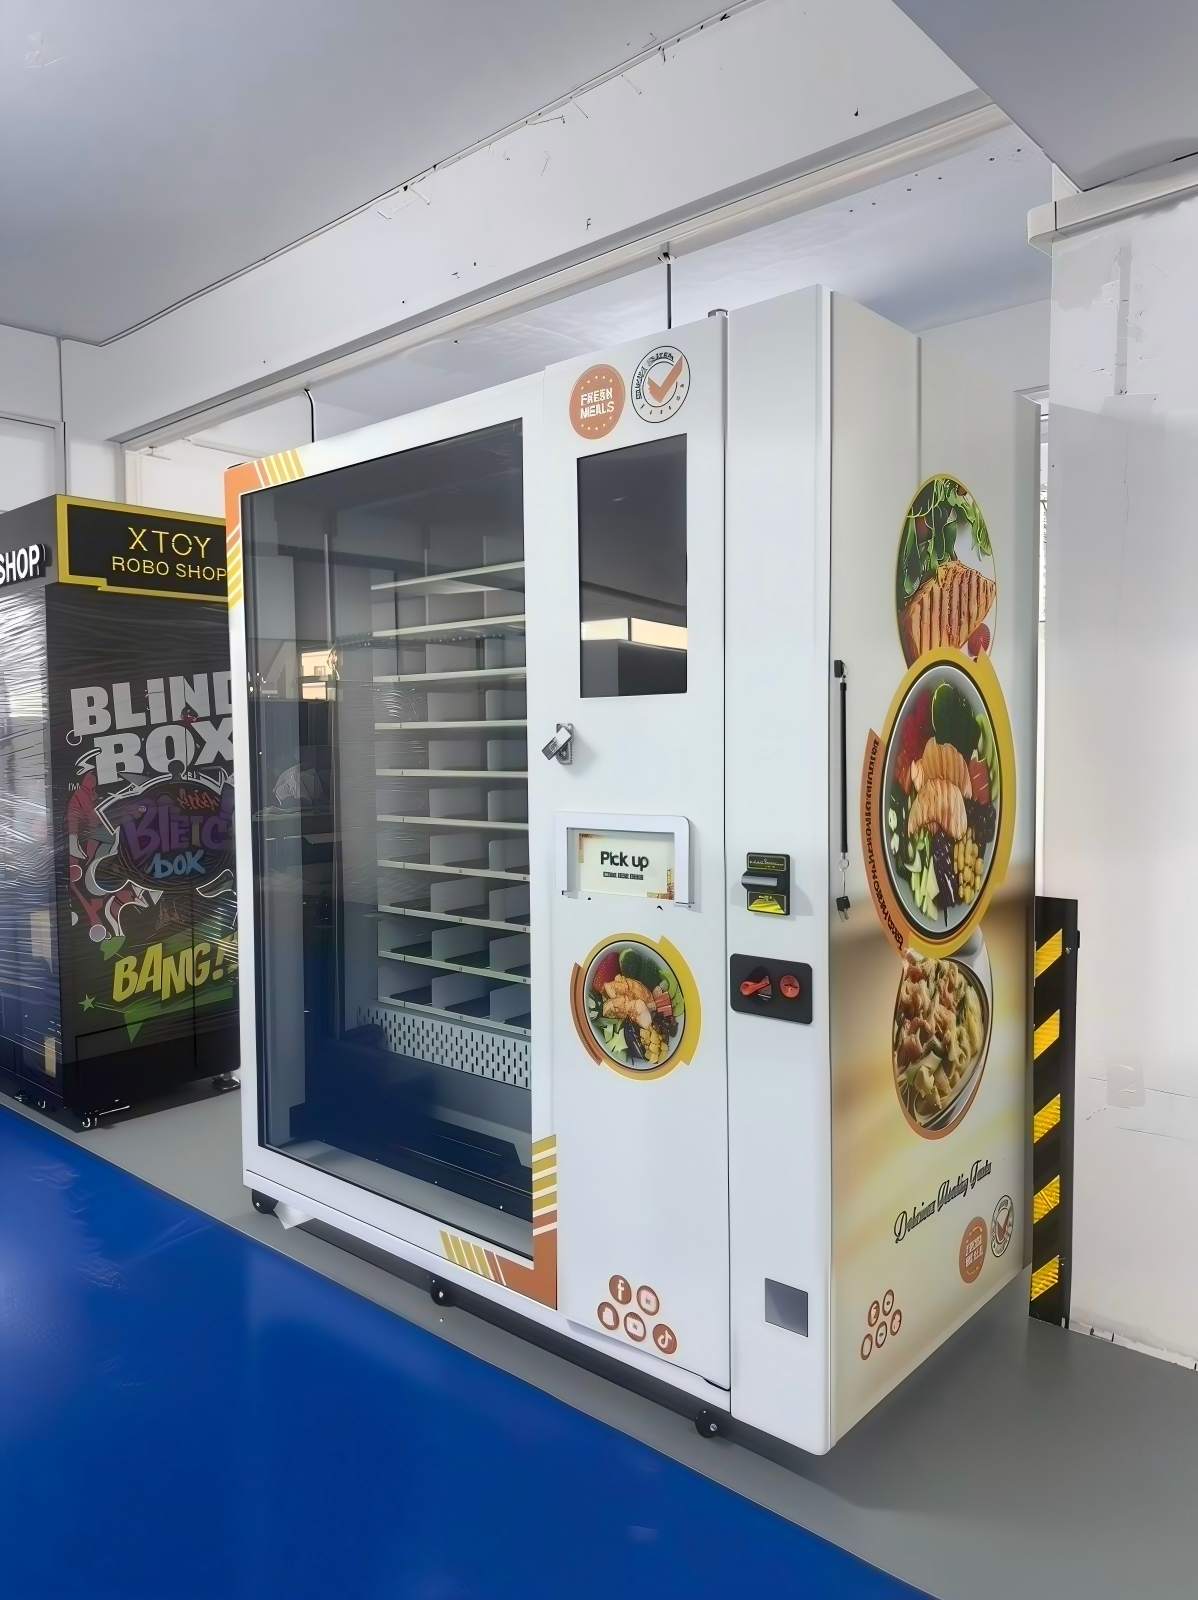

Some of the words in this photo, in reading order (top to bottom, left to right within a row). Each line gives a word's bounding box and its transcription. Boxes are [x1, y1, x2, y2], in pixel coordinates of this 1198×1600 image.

[128, 527, 212, 559] XTOY
[112, 556, 169, 576] ROBO
[175, 563, 227, 581] SHOP
[94, 717, 234, 786] BOX
[600, 851, 629, 867] Pick
[632, 855, 649, 872] up
